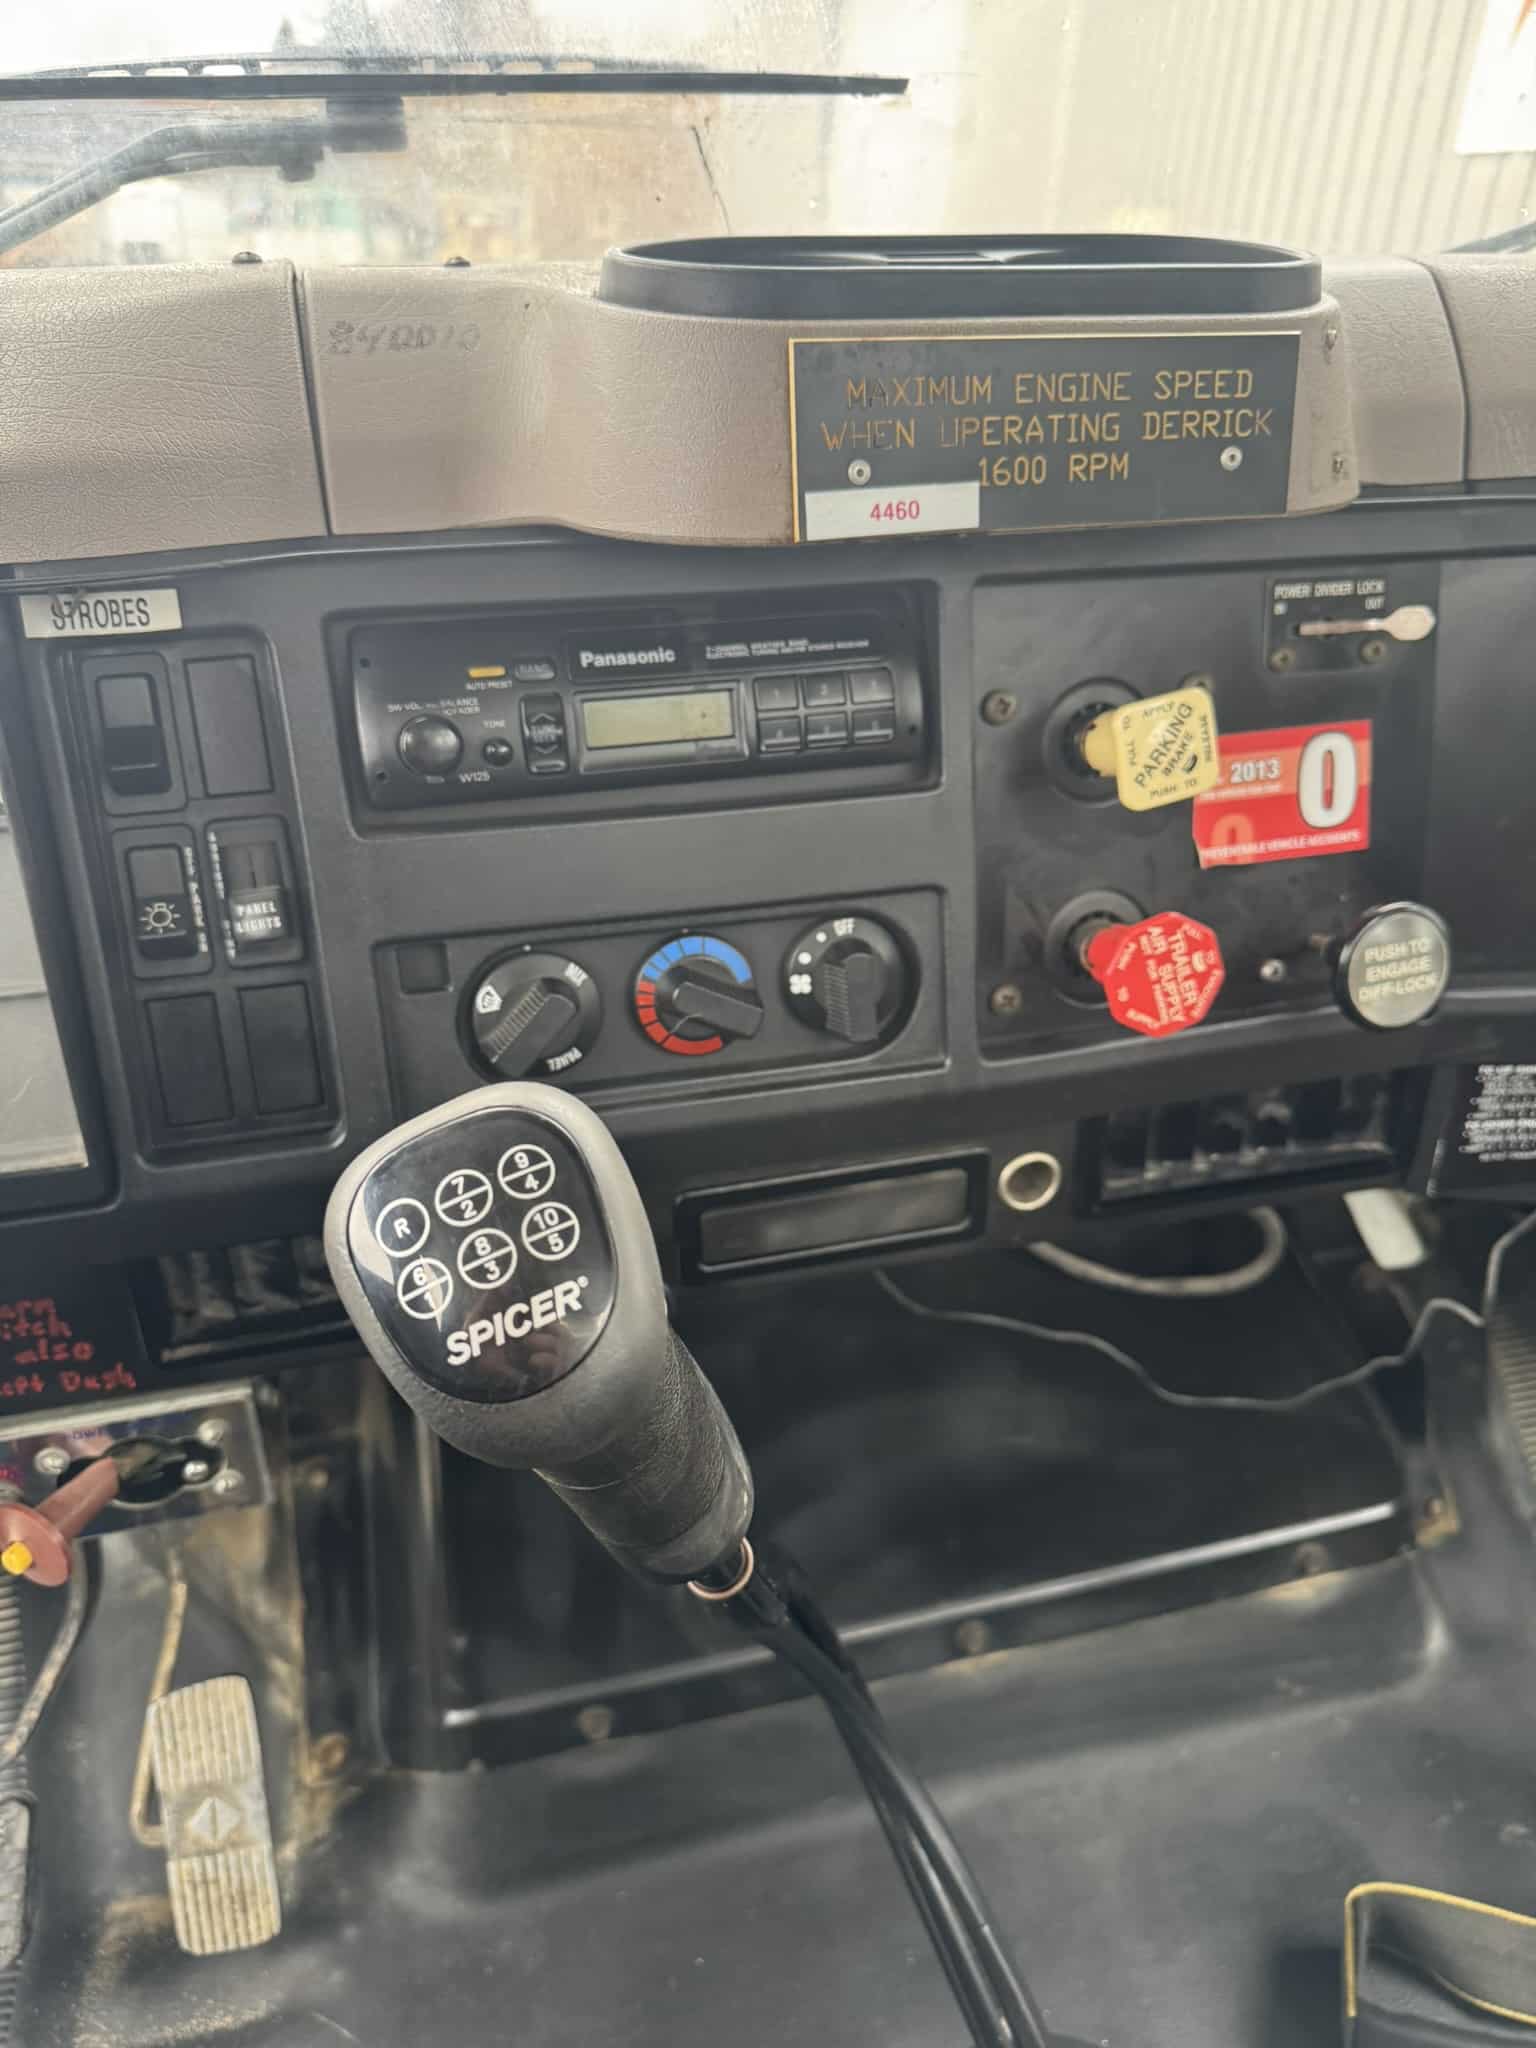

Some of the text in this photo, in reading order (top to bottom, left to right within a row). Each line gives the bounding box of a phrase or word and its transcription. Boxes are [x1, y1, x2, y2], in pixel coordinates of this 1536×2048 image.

[846, 369, 1254, 409] MAXIMUM ENGINE SPEED
[820, 418, 916, 451] WHEN
[1143, 407, 1275, 441] DERRICK
[978, 453, 1130, 487] 1600 RPM
[869, 500, 921, 521] 4460
[51, 597, 151, 632] STROBES
[580, 646, 676, 668] Panasonic
[1134, 703, 1193, 787] PARKING
[1230, 758, 1282, 784] 2013
[1297, 730, 1358, 830] 0
[1364, 937, 1431, 964] PUSH TO
[1147, 925, 1186, 1022] AIR SUPPLY
[1167, 928, 1199, 1007] TRAILER
[1365, 955, 1432, 983] ENGAGE
[1358, 973, 1435, 1003] DIFF-LOCK
[513, 1152, 529, 1170] 9
[451, 1176, 467, 1196] 7
[524, 1174, 540, 1191] 4
[460, 1200, 477, 1219] 2
[532, 1208, 560, 1230] 10
[393, 1217, 411, 1239] R
[474, 1237, 491, 1255] 8
[548, 1234, 564, 1253] 5
[411, 1266, 426, 1286] 6
[484, 1260, 500, 1280] 3
[423, 1293, 437, 1310] 1
[446, 1279, 583, 1367] SPICER
